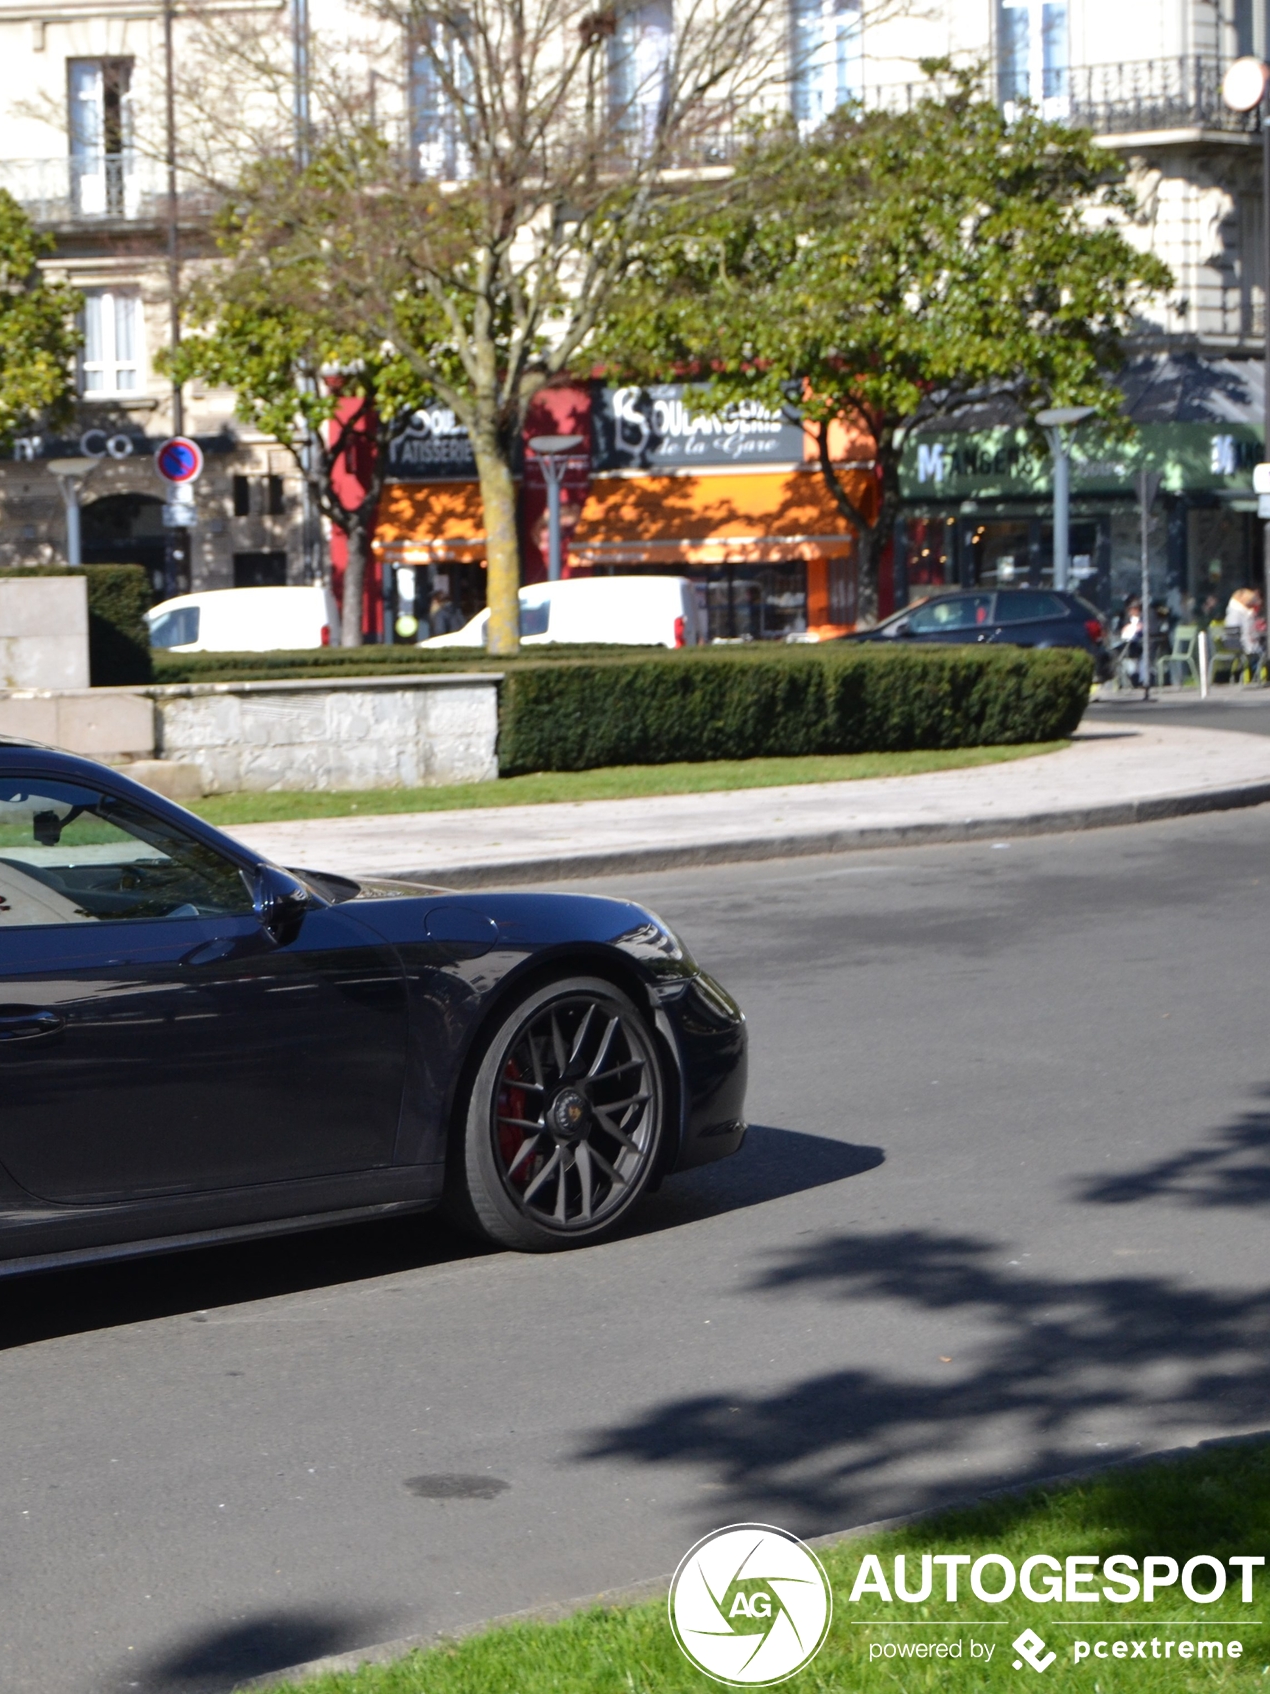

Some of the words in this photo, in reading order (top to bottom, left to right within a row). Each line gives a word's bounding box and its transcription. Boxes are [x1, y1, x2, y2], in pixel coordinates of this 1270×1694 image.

[80, 429, 133, 460] Co
[658, 436, 679, 456] de
[685, 434, 705, 455] la
[713, 432, 780, 460] Gare
